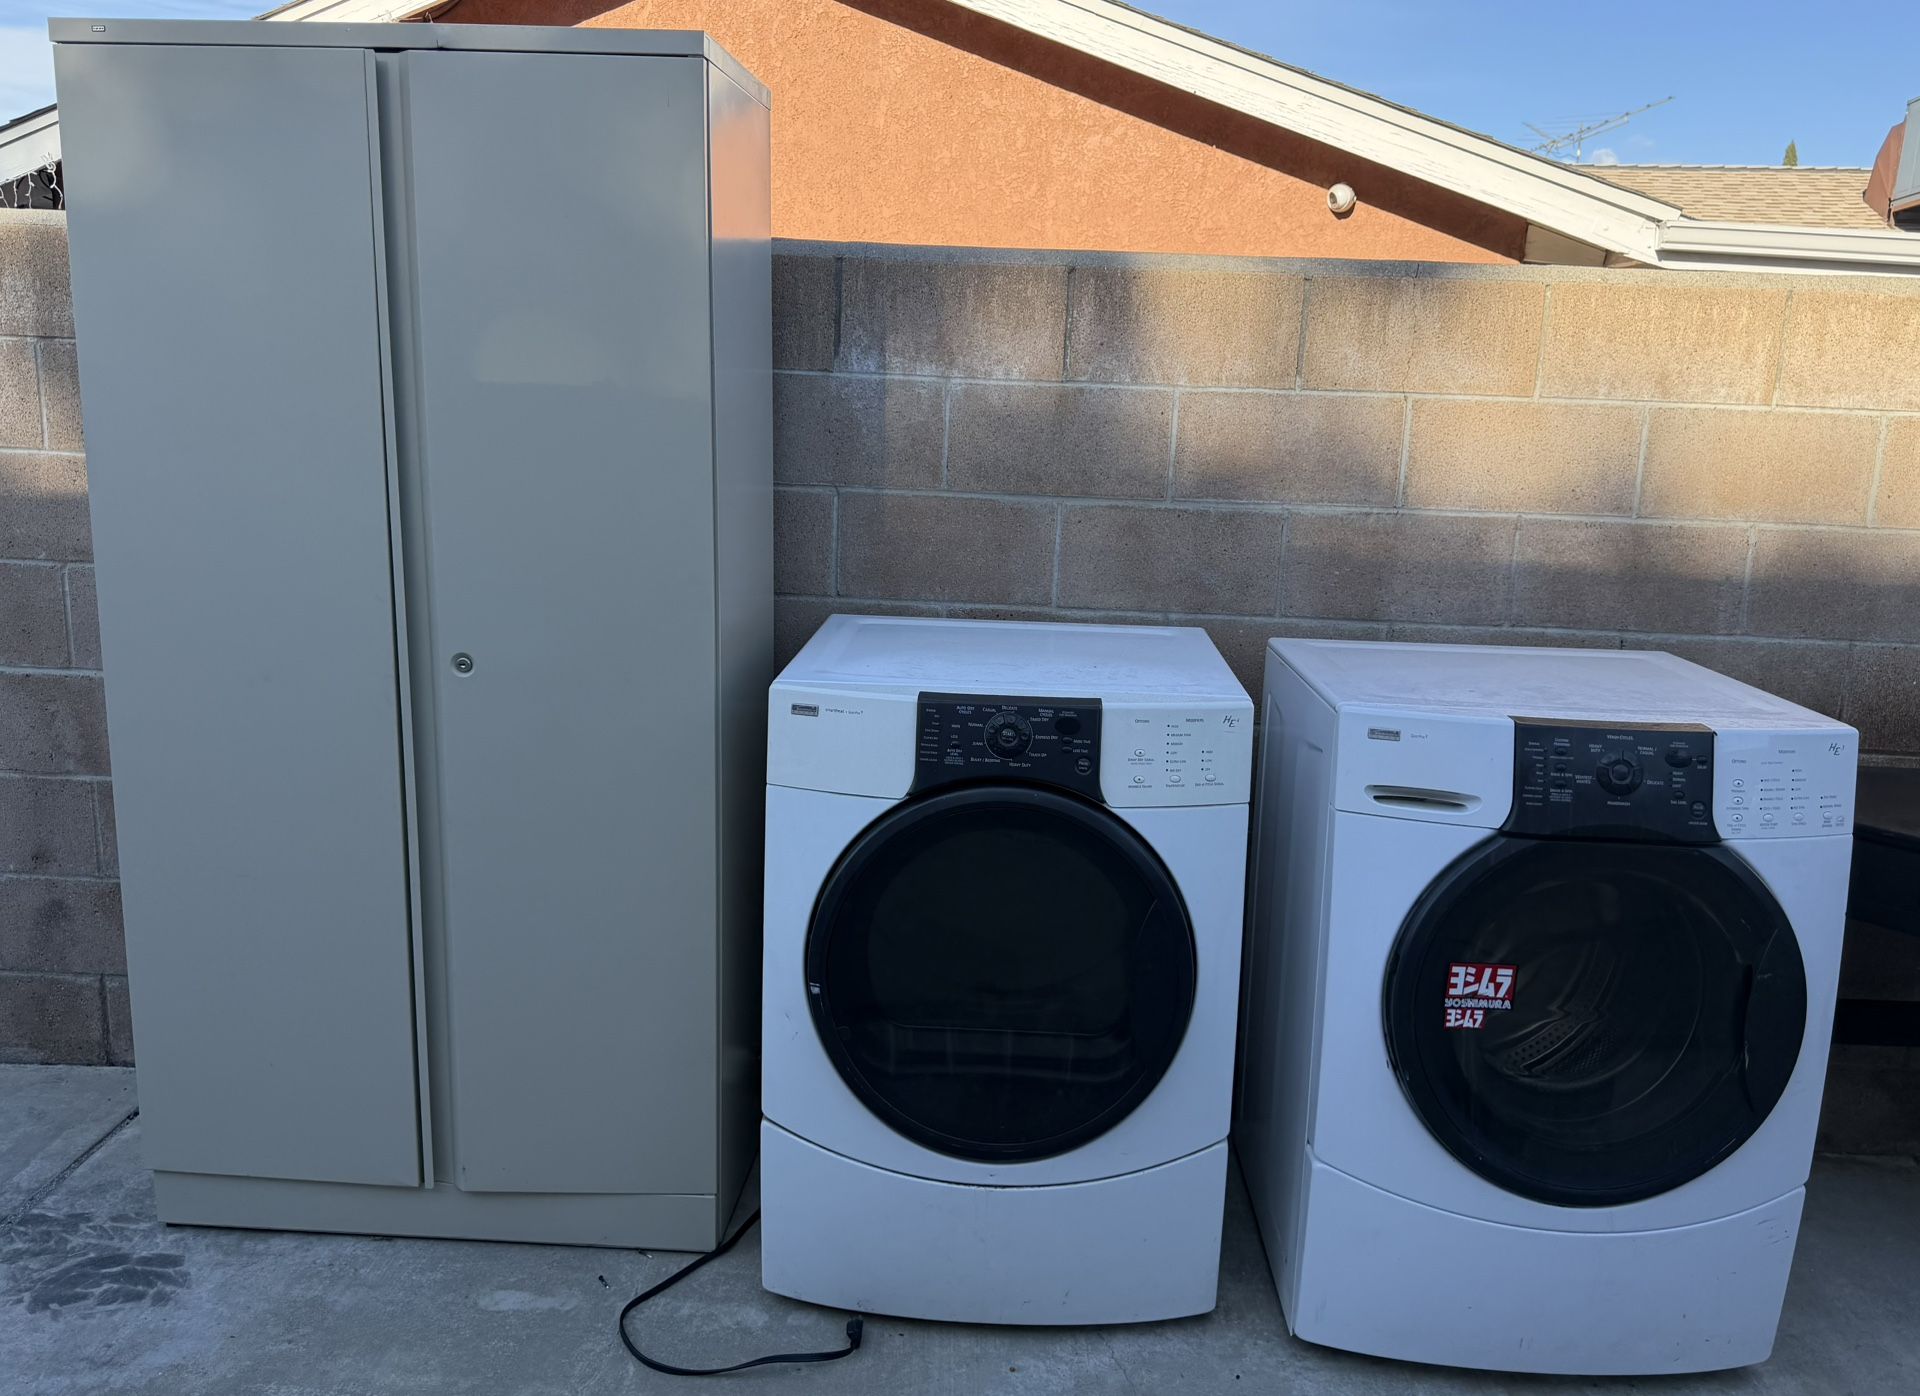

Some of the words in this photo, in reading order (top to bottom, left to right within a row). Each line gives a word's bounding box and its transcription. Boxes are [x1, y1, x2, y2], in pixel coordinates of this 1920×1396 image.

[1449, 966, 1513, 998] ヨシムラ
[1444, 997, 1511, 1010] YOSHIMURA
[1446, 1009, 1484, 1028] ヨシムラ
